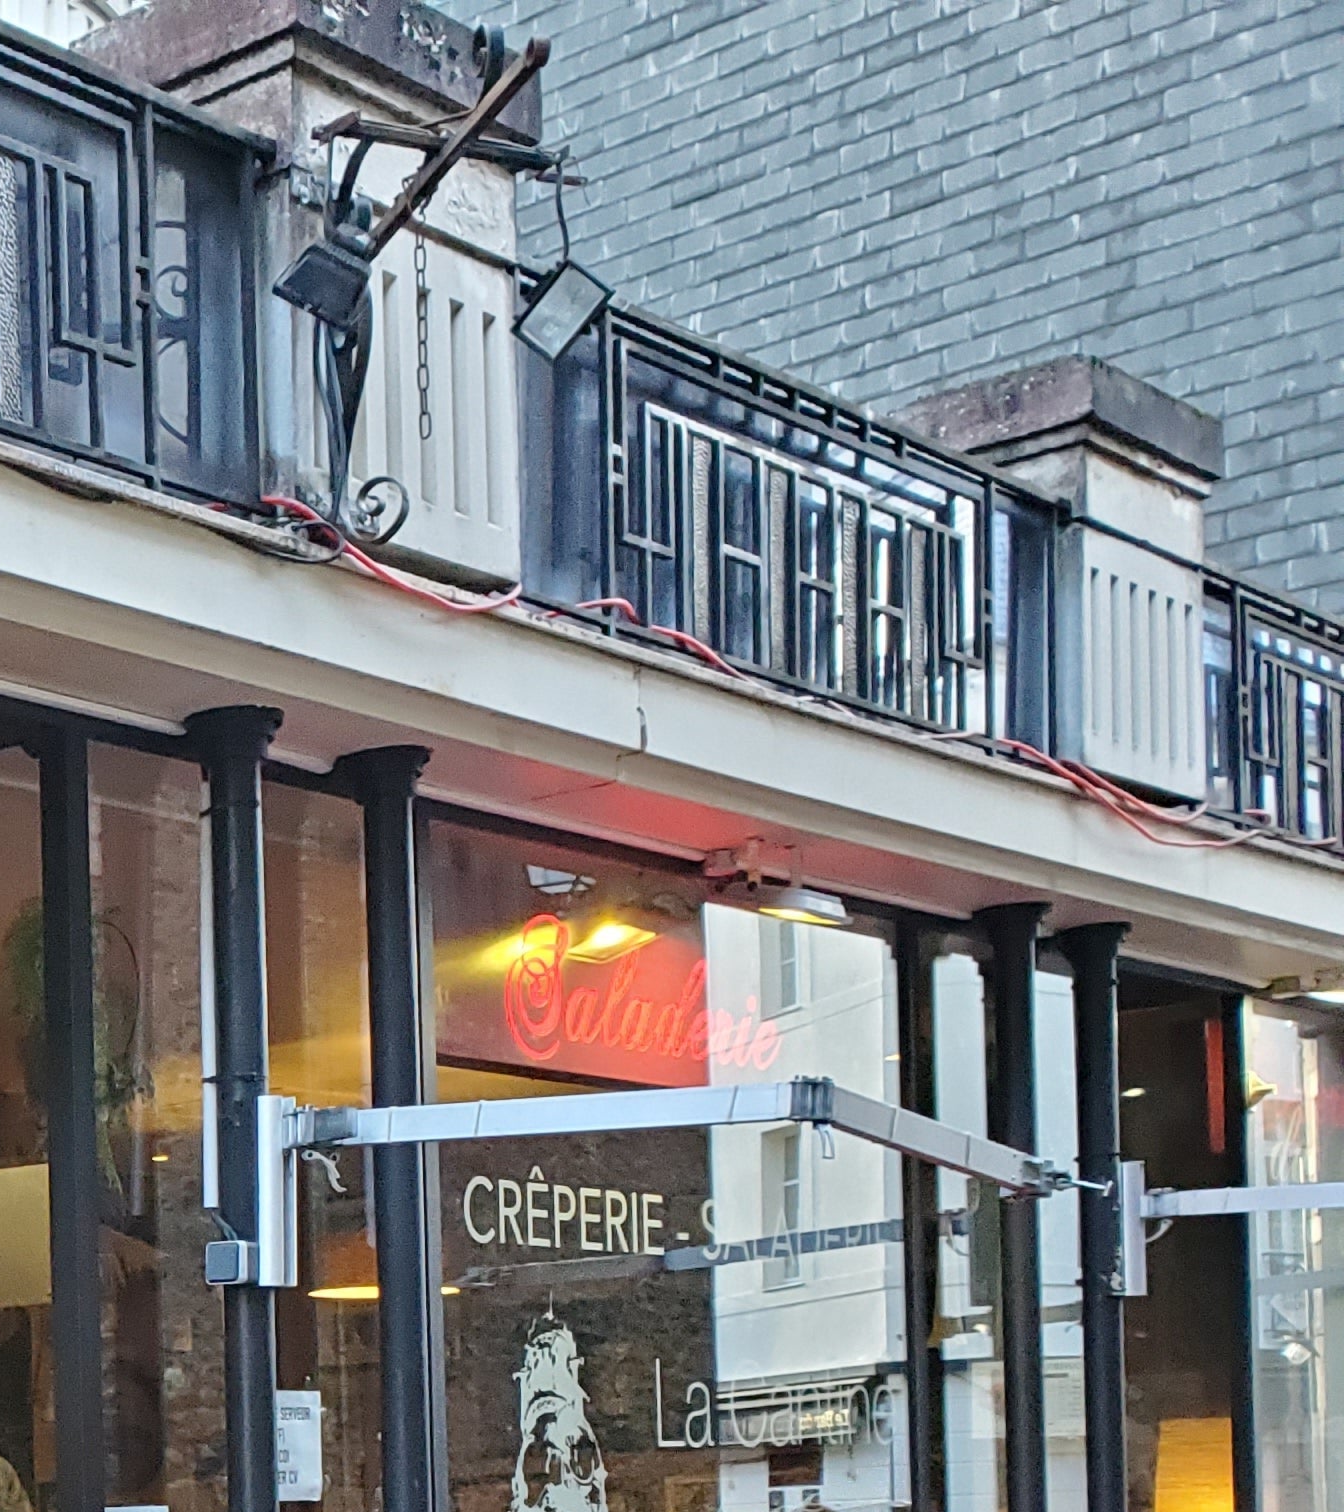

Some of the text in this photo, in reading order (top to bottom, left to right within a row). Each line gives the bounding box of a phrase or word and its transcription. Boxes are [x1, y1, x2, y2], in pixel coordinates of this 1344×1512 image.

[503, 912, 785, 1072] Saladerie
[462, 1165, 665, 1257] CRÊPERIE
[655, 1357, 715, 1449] La
